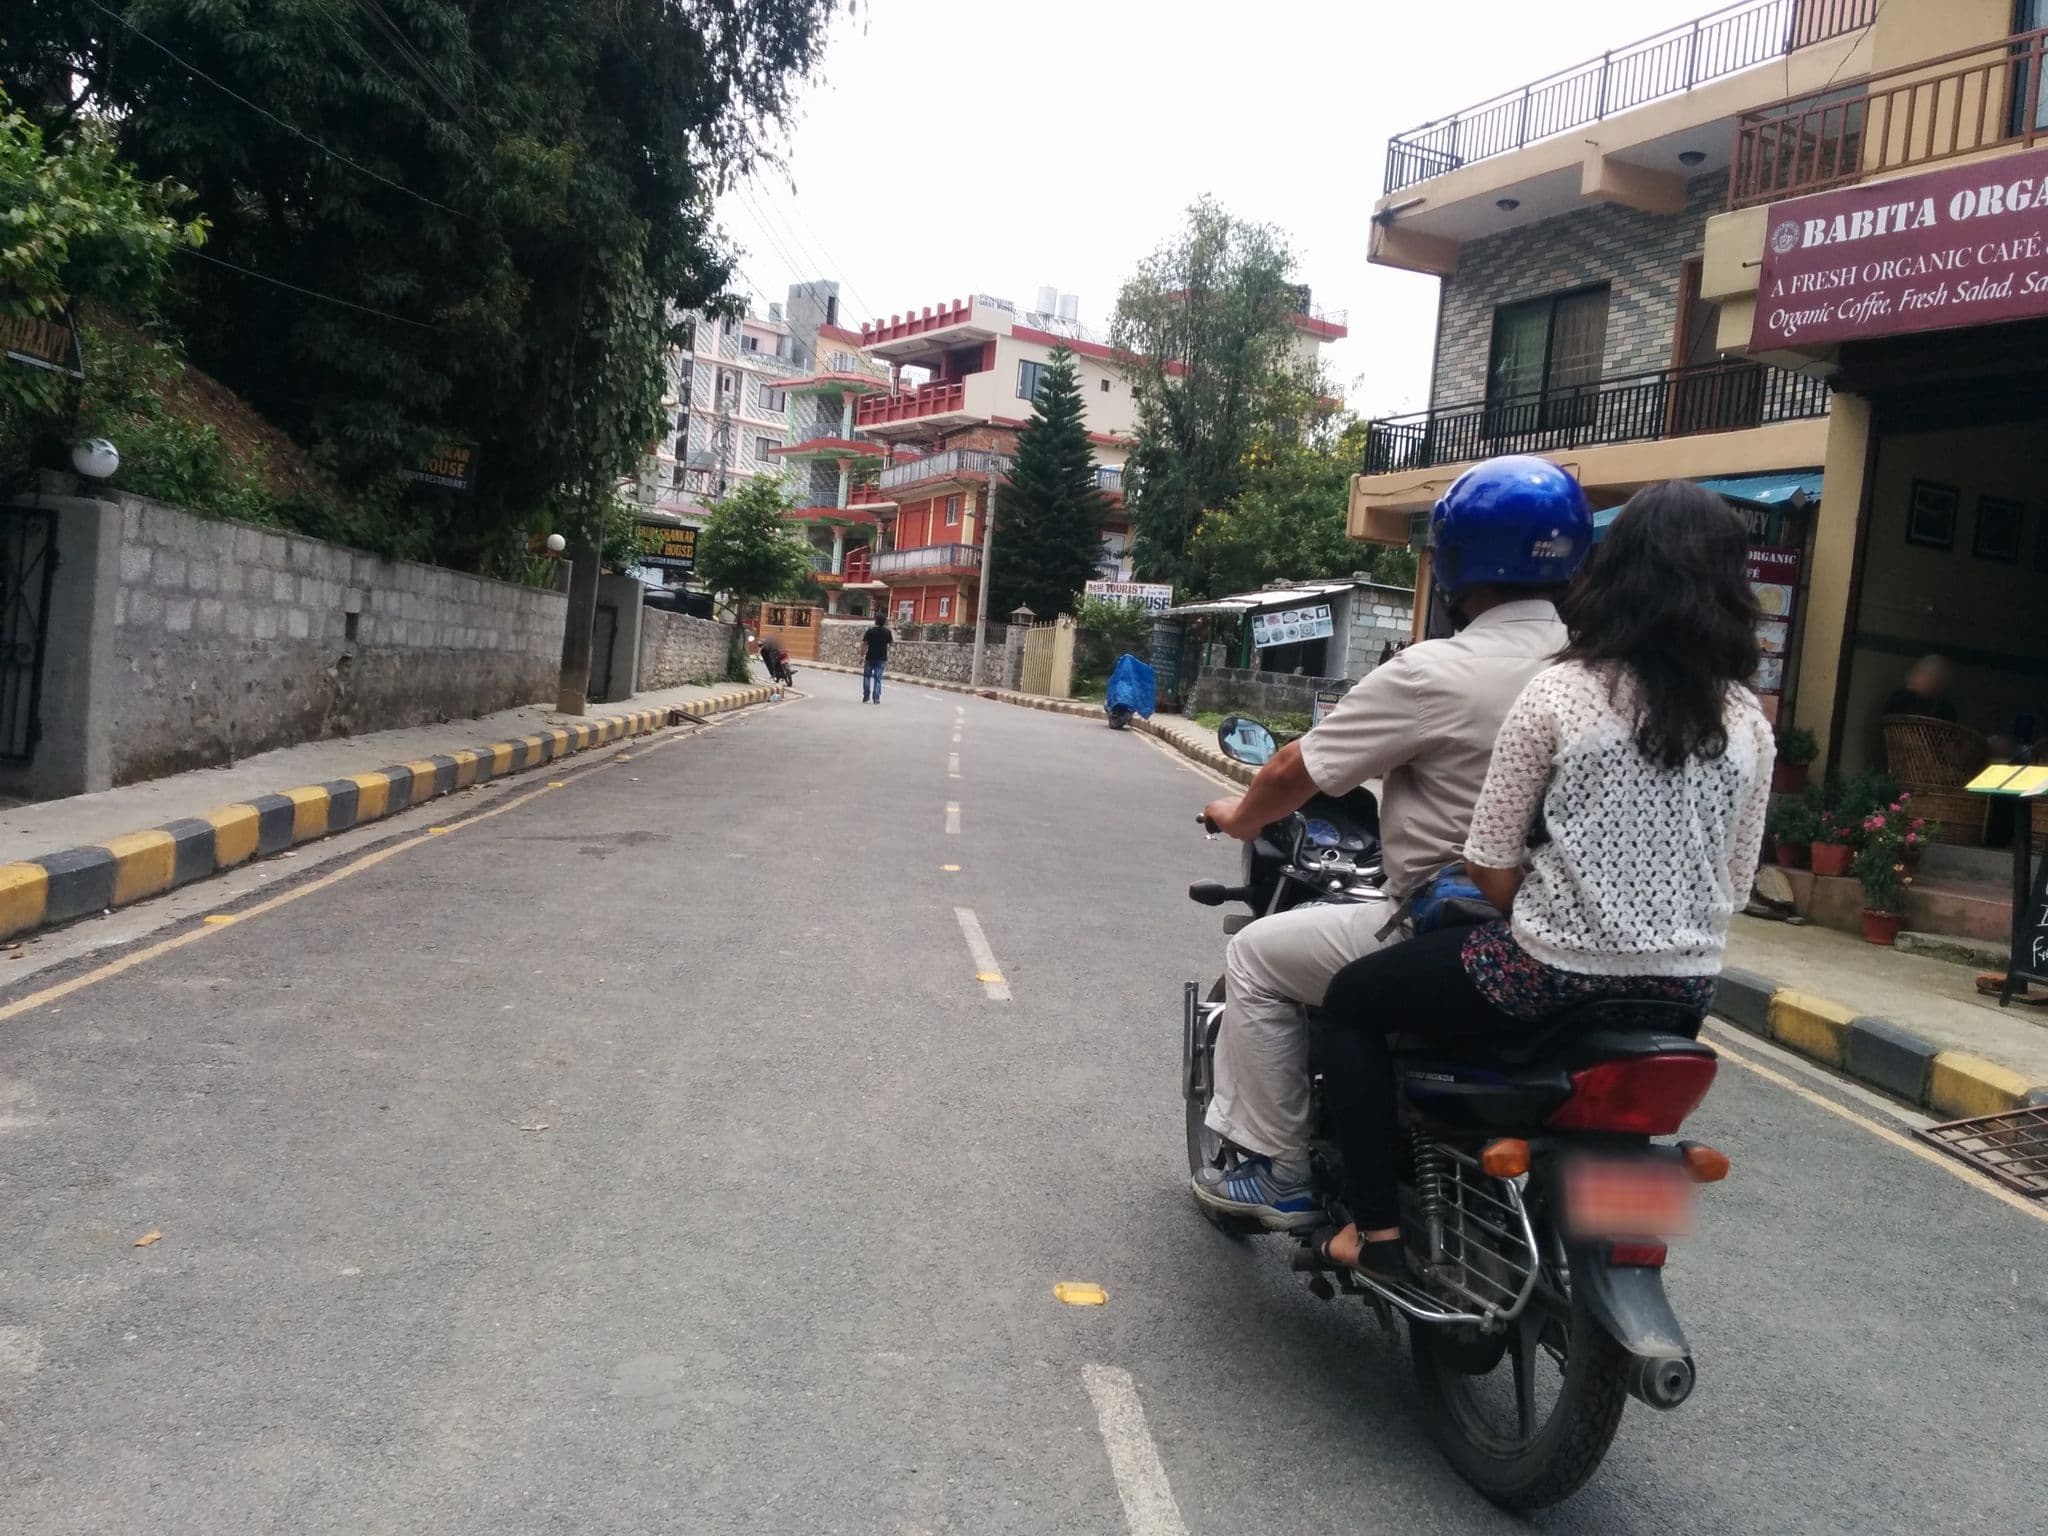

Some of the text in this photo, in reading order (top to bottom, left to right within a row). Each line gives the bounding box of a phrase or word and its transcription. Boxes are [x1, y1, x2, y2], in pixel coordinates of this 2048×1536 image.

[1801, 197, 1937, 249] BABITA
[1949, 175, 2048, 221] ORGA
[1771, 231, 2041, 297] A FRESH ORGANIC CAFÉ
[1769, 302, 1834, 337] Organic
[1837, 290, 1892, 325] Coffee,
[1898, 281, 1948, 312] Fresh
[1952, 271, 2015, 303] Salad,
[665, 543, 693, 558] HOUSE
[1106, 584, 1146, 594] TOURIST
[1746, 567, 1760, 579] FÉ
